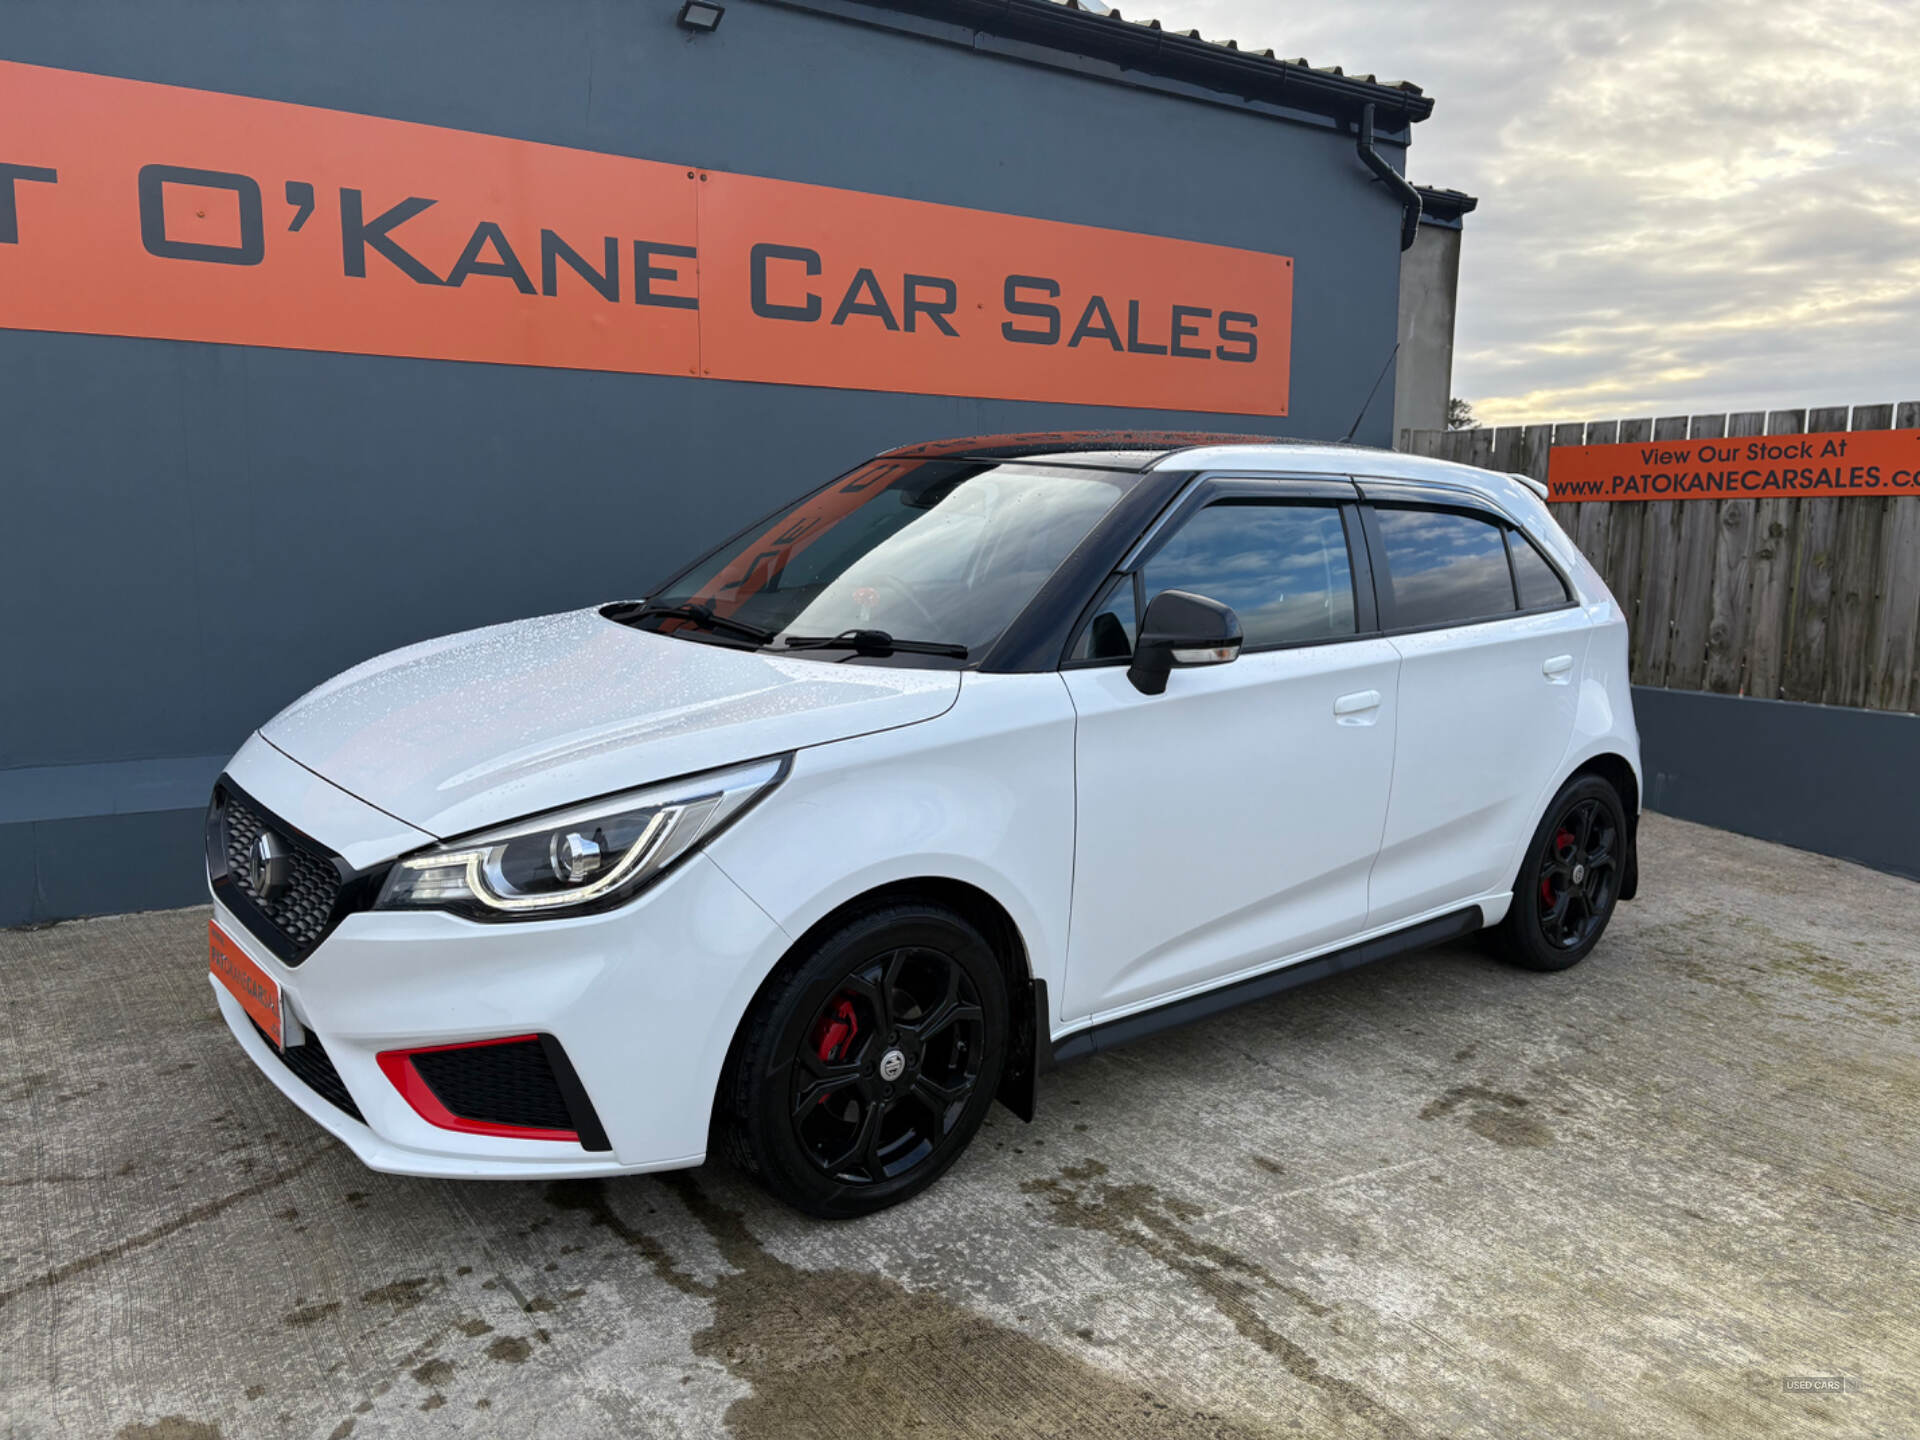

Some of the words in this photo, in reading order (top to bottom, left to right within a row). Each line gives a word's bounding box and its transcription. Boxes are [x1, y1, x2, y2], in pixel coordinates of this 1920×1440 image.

[138, 163, 699, 311] O'KANE
[750, 242, 961, 338] CAR
[1001, 274, 1259, 363] SALES
[1641, 448, 1691, 465] View
[1698, 445, 1740, 463] Our
[1746, 441, 1814, 461] Stock
[1820, 439, 1847, 458] At
